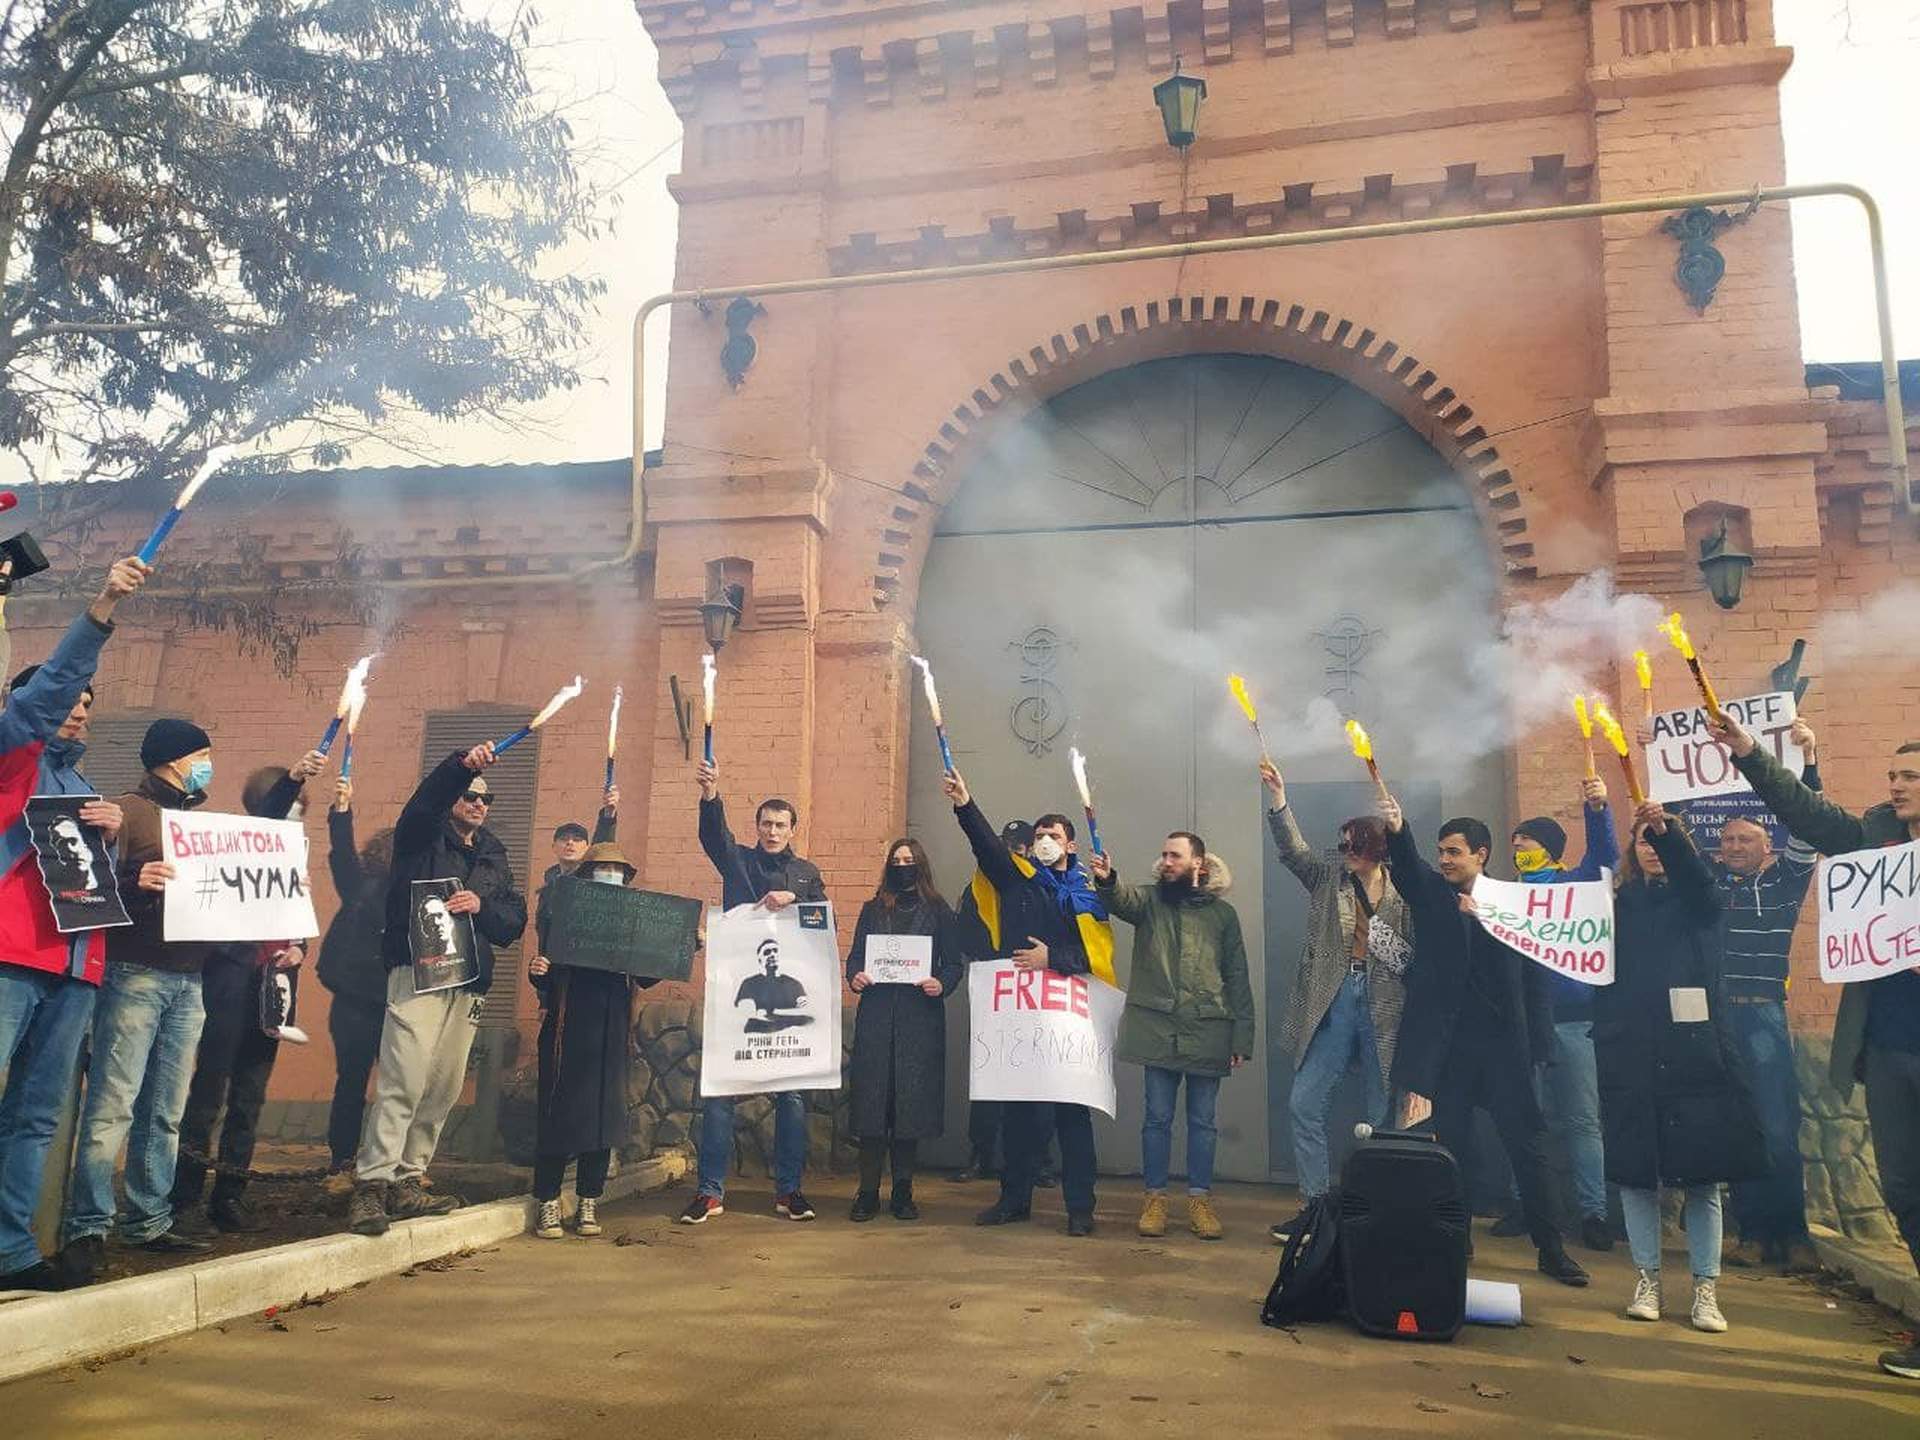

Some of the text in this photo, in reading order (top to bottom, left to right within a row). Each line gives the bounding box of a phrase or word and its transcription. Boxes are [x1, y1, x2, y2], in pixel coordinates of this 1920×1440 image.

[1661, 725, 1793, 788] ЧОТ
[169, 820, 285, 858] ВЕНЕДИКТОВА
[195, 864, 304, 910] #ЧУМА
[1527, 887, 1574, 919] НІ
[994, 969, 1089, 1019] FREE
